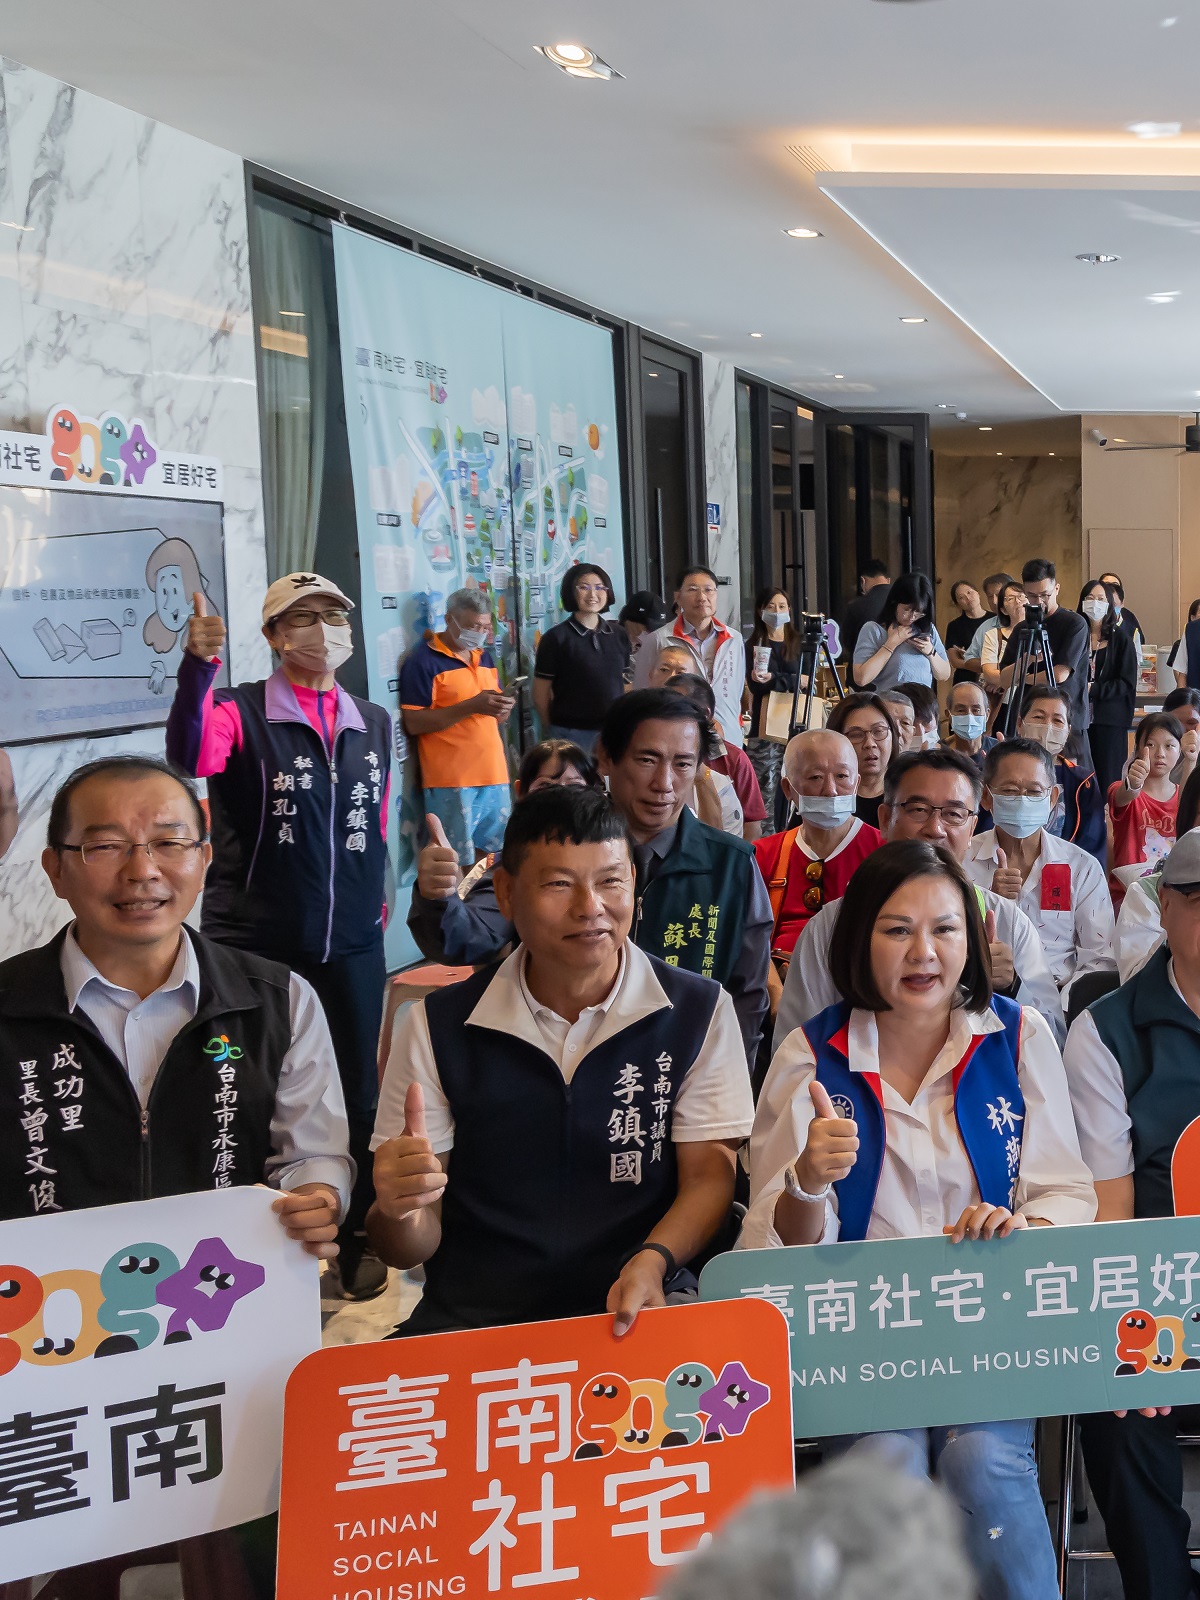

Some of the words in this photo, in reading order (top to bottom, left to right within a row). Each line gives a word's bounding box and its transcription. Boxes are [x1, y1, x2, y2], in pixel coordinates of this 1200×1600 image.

[0, 442, 41, 472] 社宅
[162, 460, 218, 489] 宜居好宅
[272, 772, 297, 845] 胡孔貞
[345, 781, 370, 853] 李鎮國
[688, 903, 704, 938] 處長
[52, 1043, 84, 1131] 成功里
[650, 1051, 673, 1163] 台南市議員
[607, 1063, 648, 1185] 李鎮國
[791, 1365, 847, 1388] NAN
[859, 1356, 963, 1382] SOCIAL
[972, 1344, 1101, 1373] HOUSING
[0, 1381, 226, 1527] 臺南
[335, 1357, 579, 1492] 臺南
[332, 1545, 439, 1577] SOCIAL
[334, 1510, 438, 1541] TAINAN
[468, 1456, 713, 1593] 社宅
